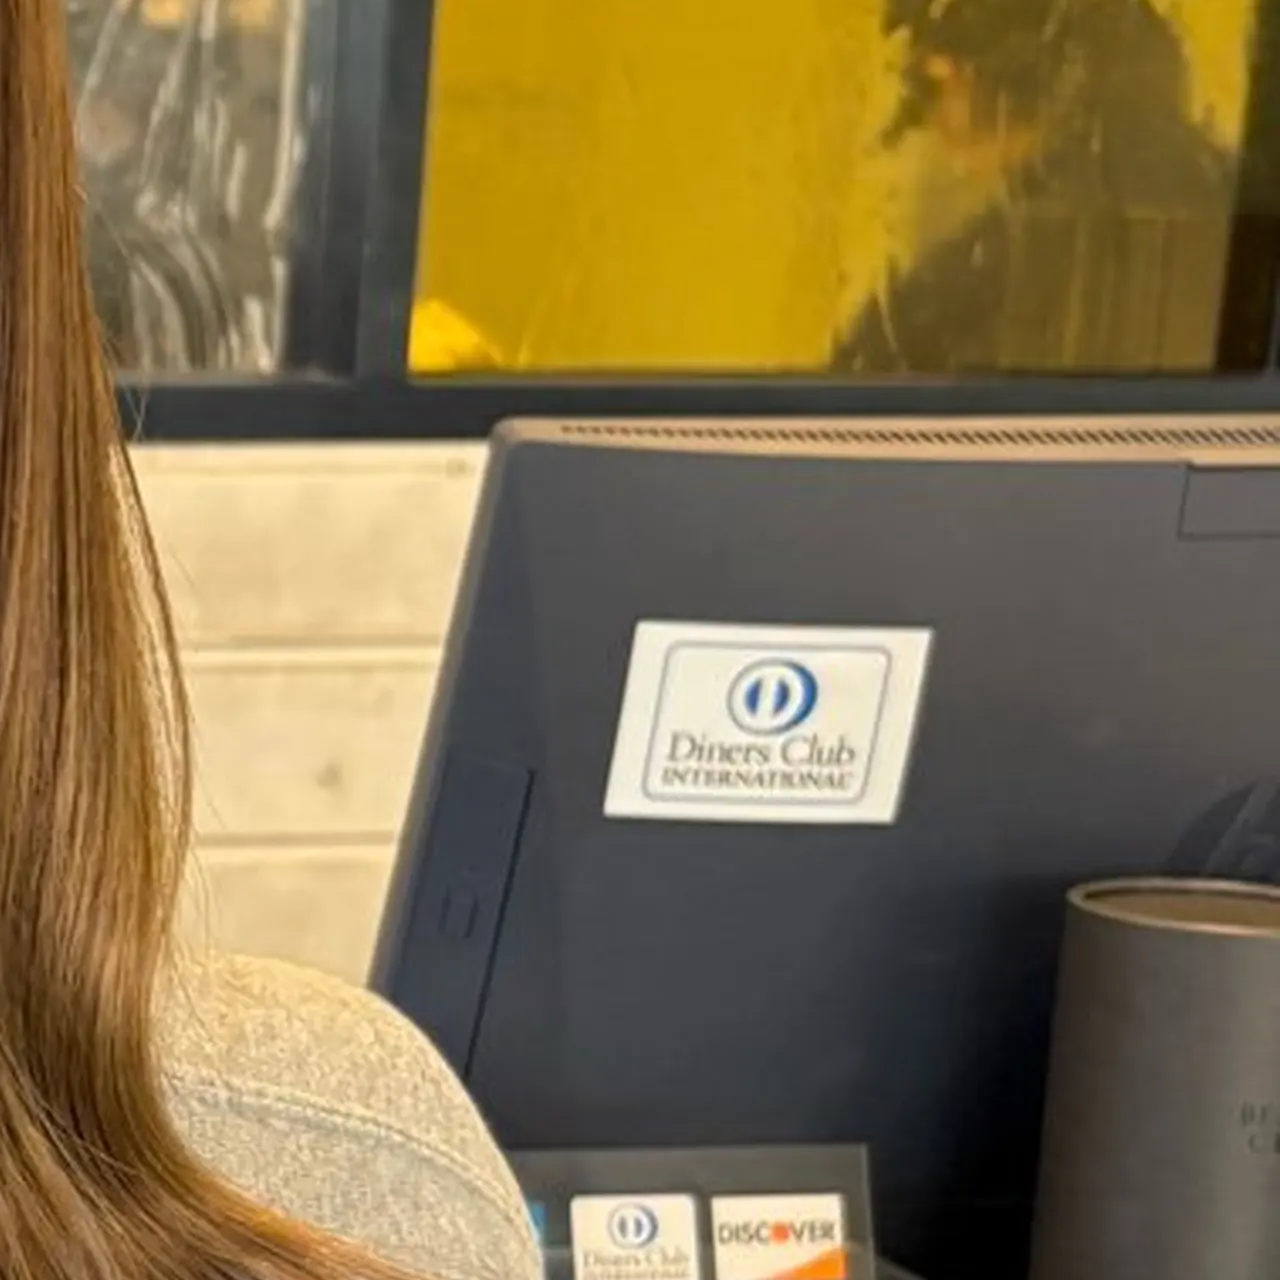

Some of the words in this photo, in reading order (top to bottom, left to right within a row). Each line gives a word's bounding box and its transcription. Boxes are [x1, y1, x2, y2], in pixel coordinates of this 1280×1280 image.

[667, 731, 771, 765] Diners
[780, 731, 857, 767] Club
[661, 768, 855, 791] INTERNATIONAL
[718, 1220, 836, 1244] DISCOVER
